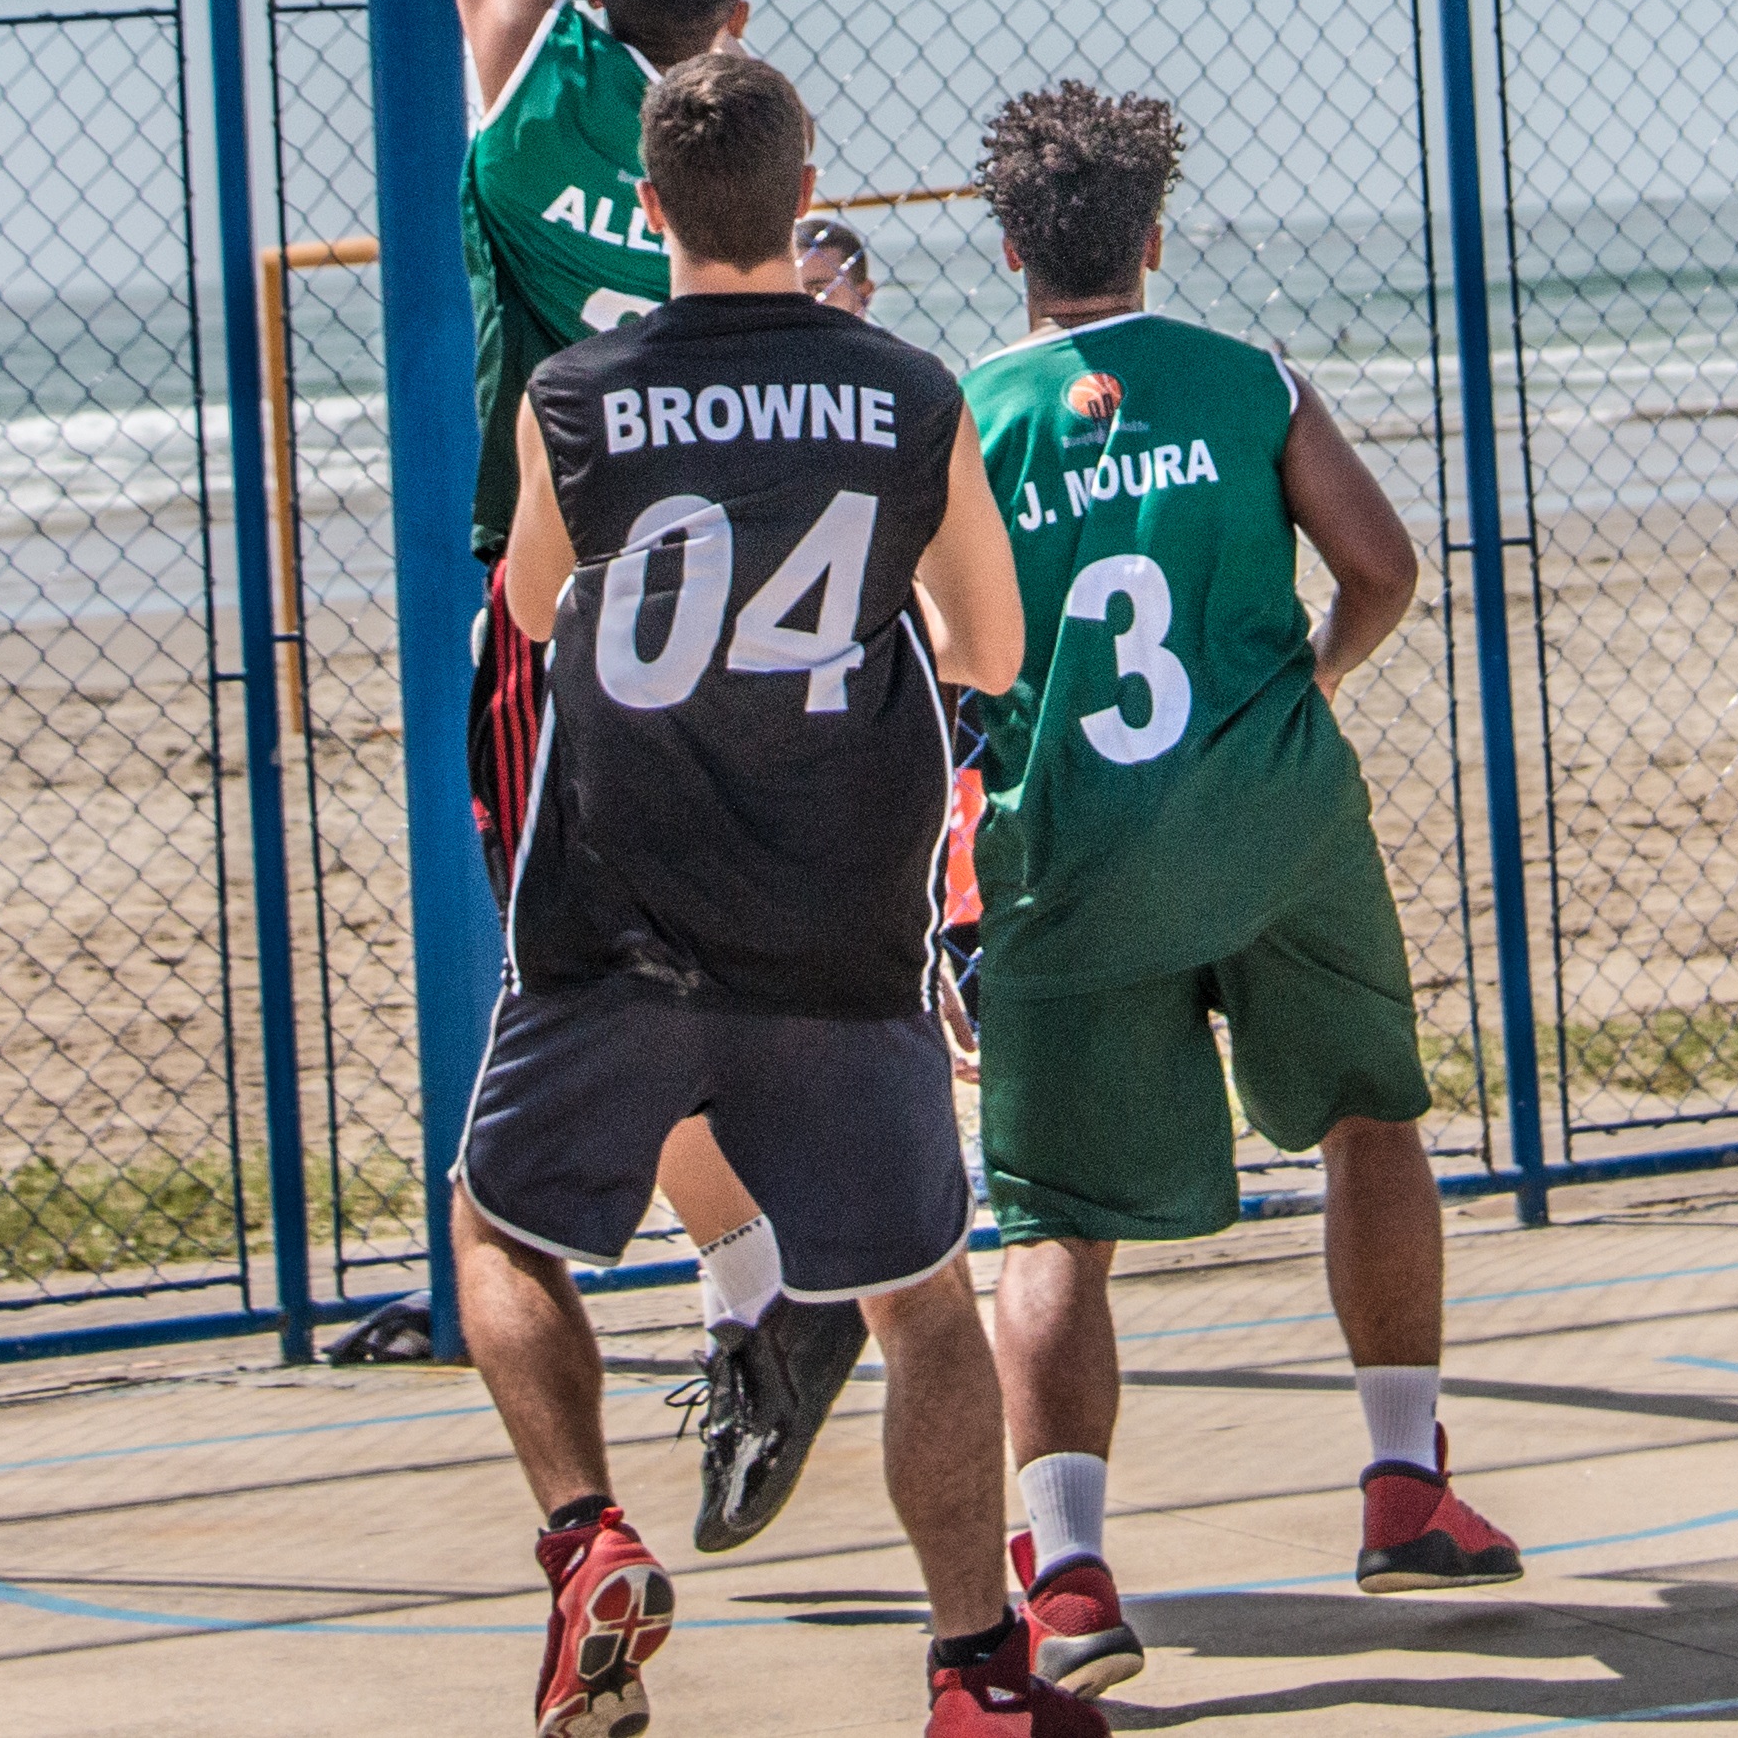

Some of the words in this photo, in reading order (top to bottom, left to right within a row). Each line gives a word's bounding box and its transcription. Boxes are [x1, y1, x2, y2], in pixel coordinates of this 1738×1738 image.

[541, 185, 670, 256] ALL
[603, 383, 897, 455] BROWNE
[1017, 481, 1057, 532] J.
[1063, 439, 1219, 518] MOURA
[595, 490, 879, 713] 04
[1065, 554, 1193, 765] 3
